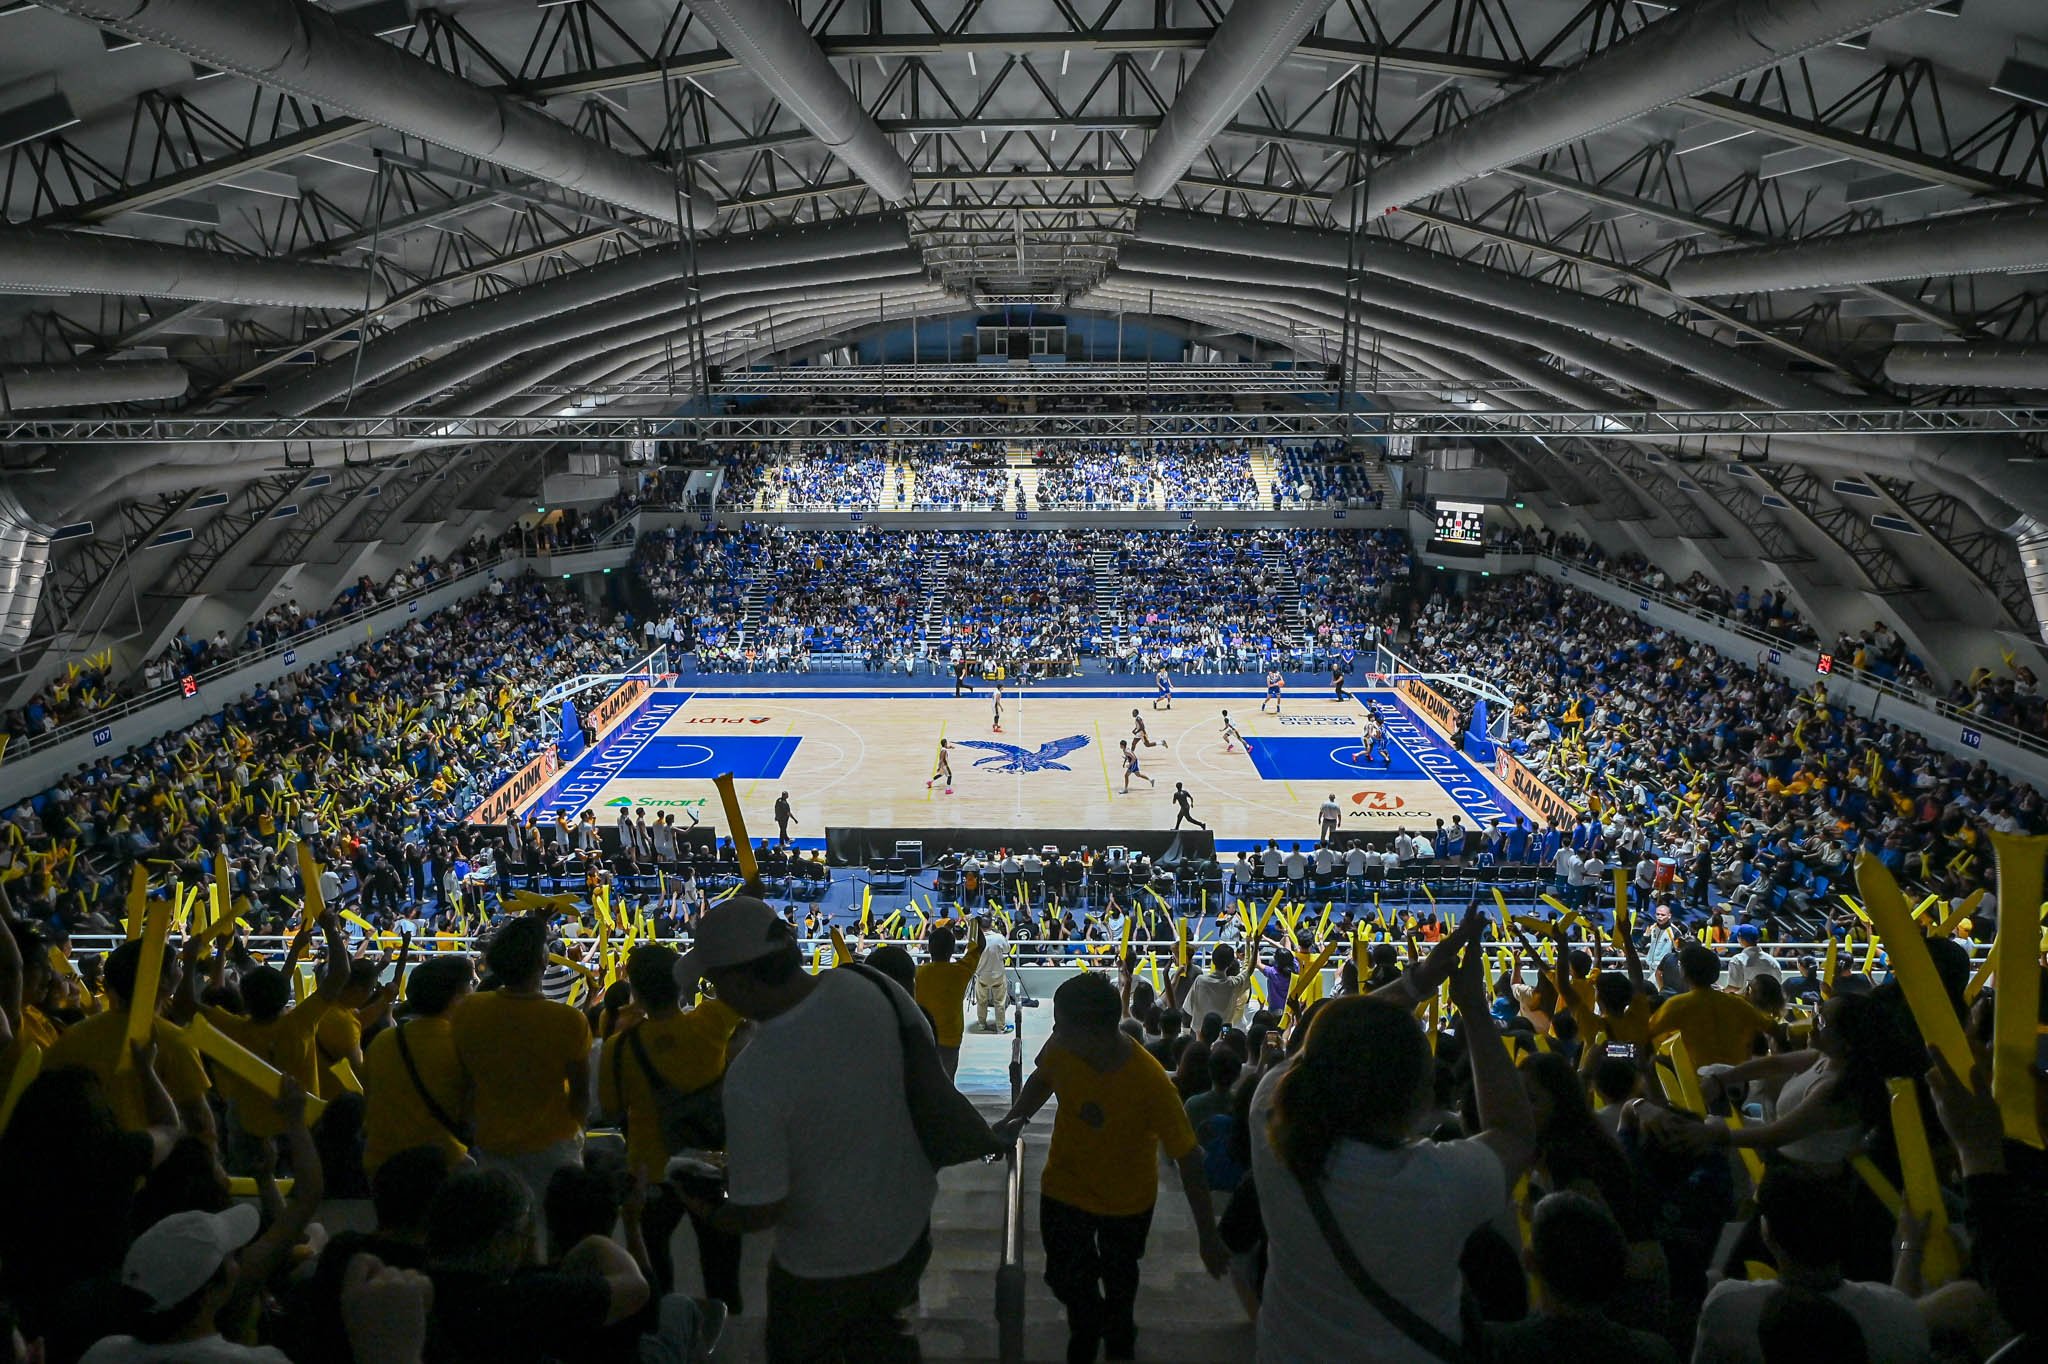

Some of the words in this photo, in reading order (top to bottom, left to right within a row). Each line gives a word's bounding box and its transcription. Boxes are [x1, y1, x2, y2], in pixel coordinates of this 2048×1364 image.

[601, 695, 620, 724] SLAM
[621, 684, 639, 708] DUNK
[1407, 680, 1427, 705] SLAM
[1427, 695, 1450, 723] DUNK
[95, 729, 110, 743] 107
[577, 733, 650, 780] EAGLE
[632, 704, 679, 731] GYM
[1963, 732, 1979, 745] 119
[481, 793, 511, 824] SLAM
[512, 762, 542, 802] DUNK
[636, 797, 708, 807] Smart
[1398, 736, 1472, 783] EAGLE
[1452, 787, 1517, 828] GYM
[1512, 768, 1542, 808] SLAM
[1543, 796, 1577, 832] DUNK
[1533, 842, 1542, 851] 23
